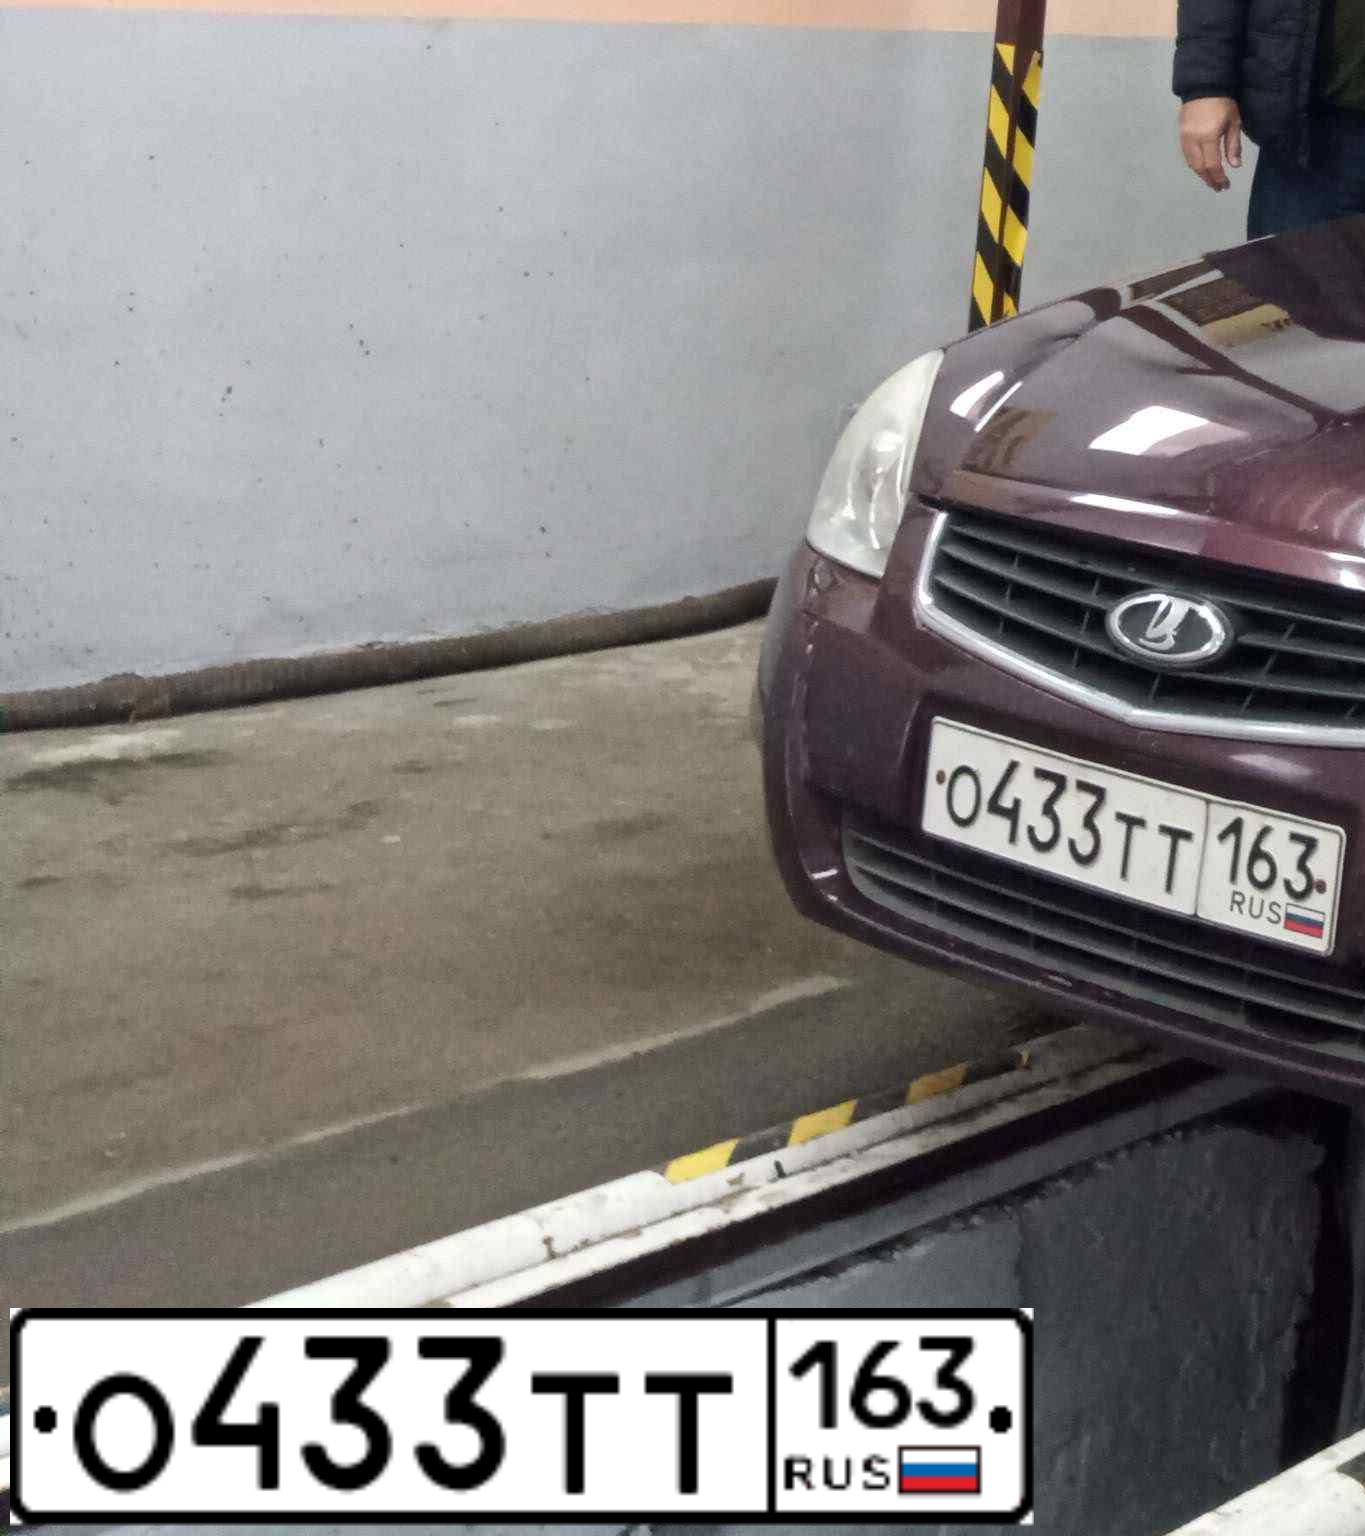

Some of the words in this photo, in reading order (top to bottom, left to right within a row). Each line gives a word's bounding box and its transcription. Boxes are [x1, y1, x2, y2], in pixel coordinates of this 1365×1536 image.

[946, 760, 1194, 894] О433ТТ
[1217, 816, 1319, 900] 163
[1230, 889, 1282, 925] RUS
